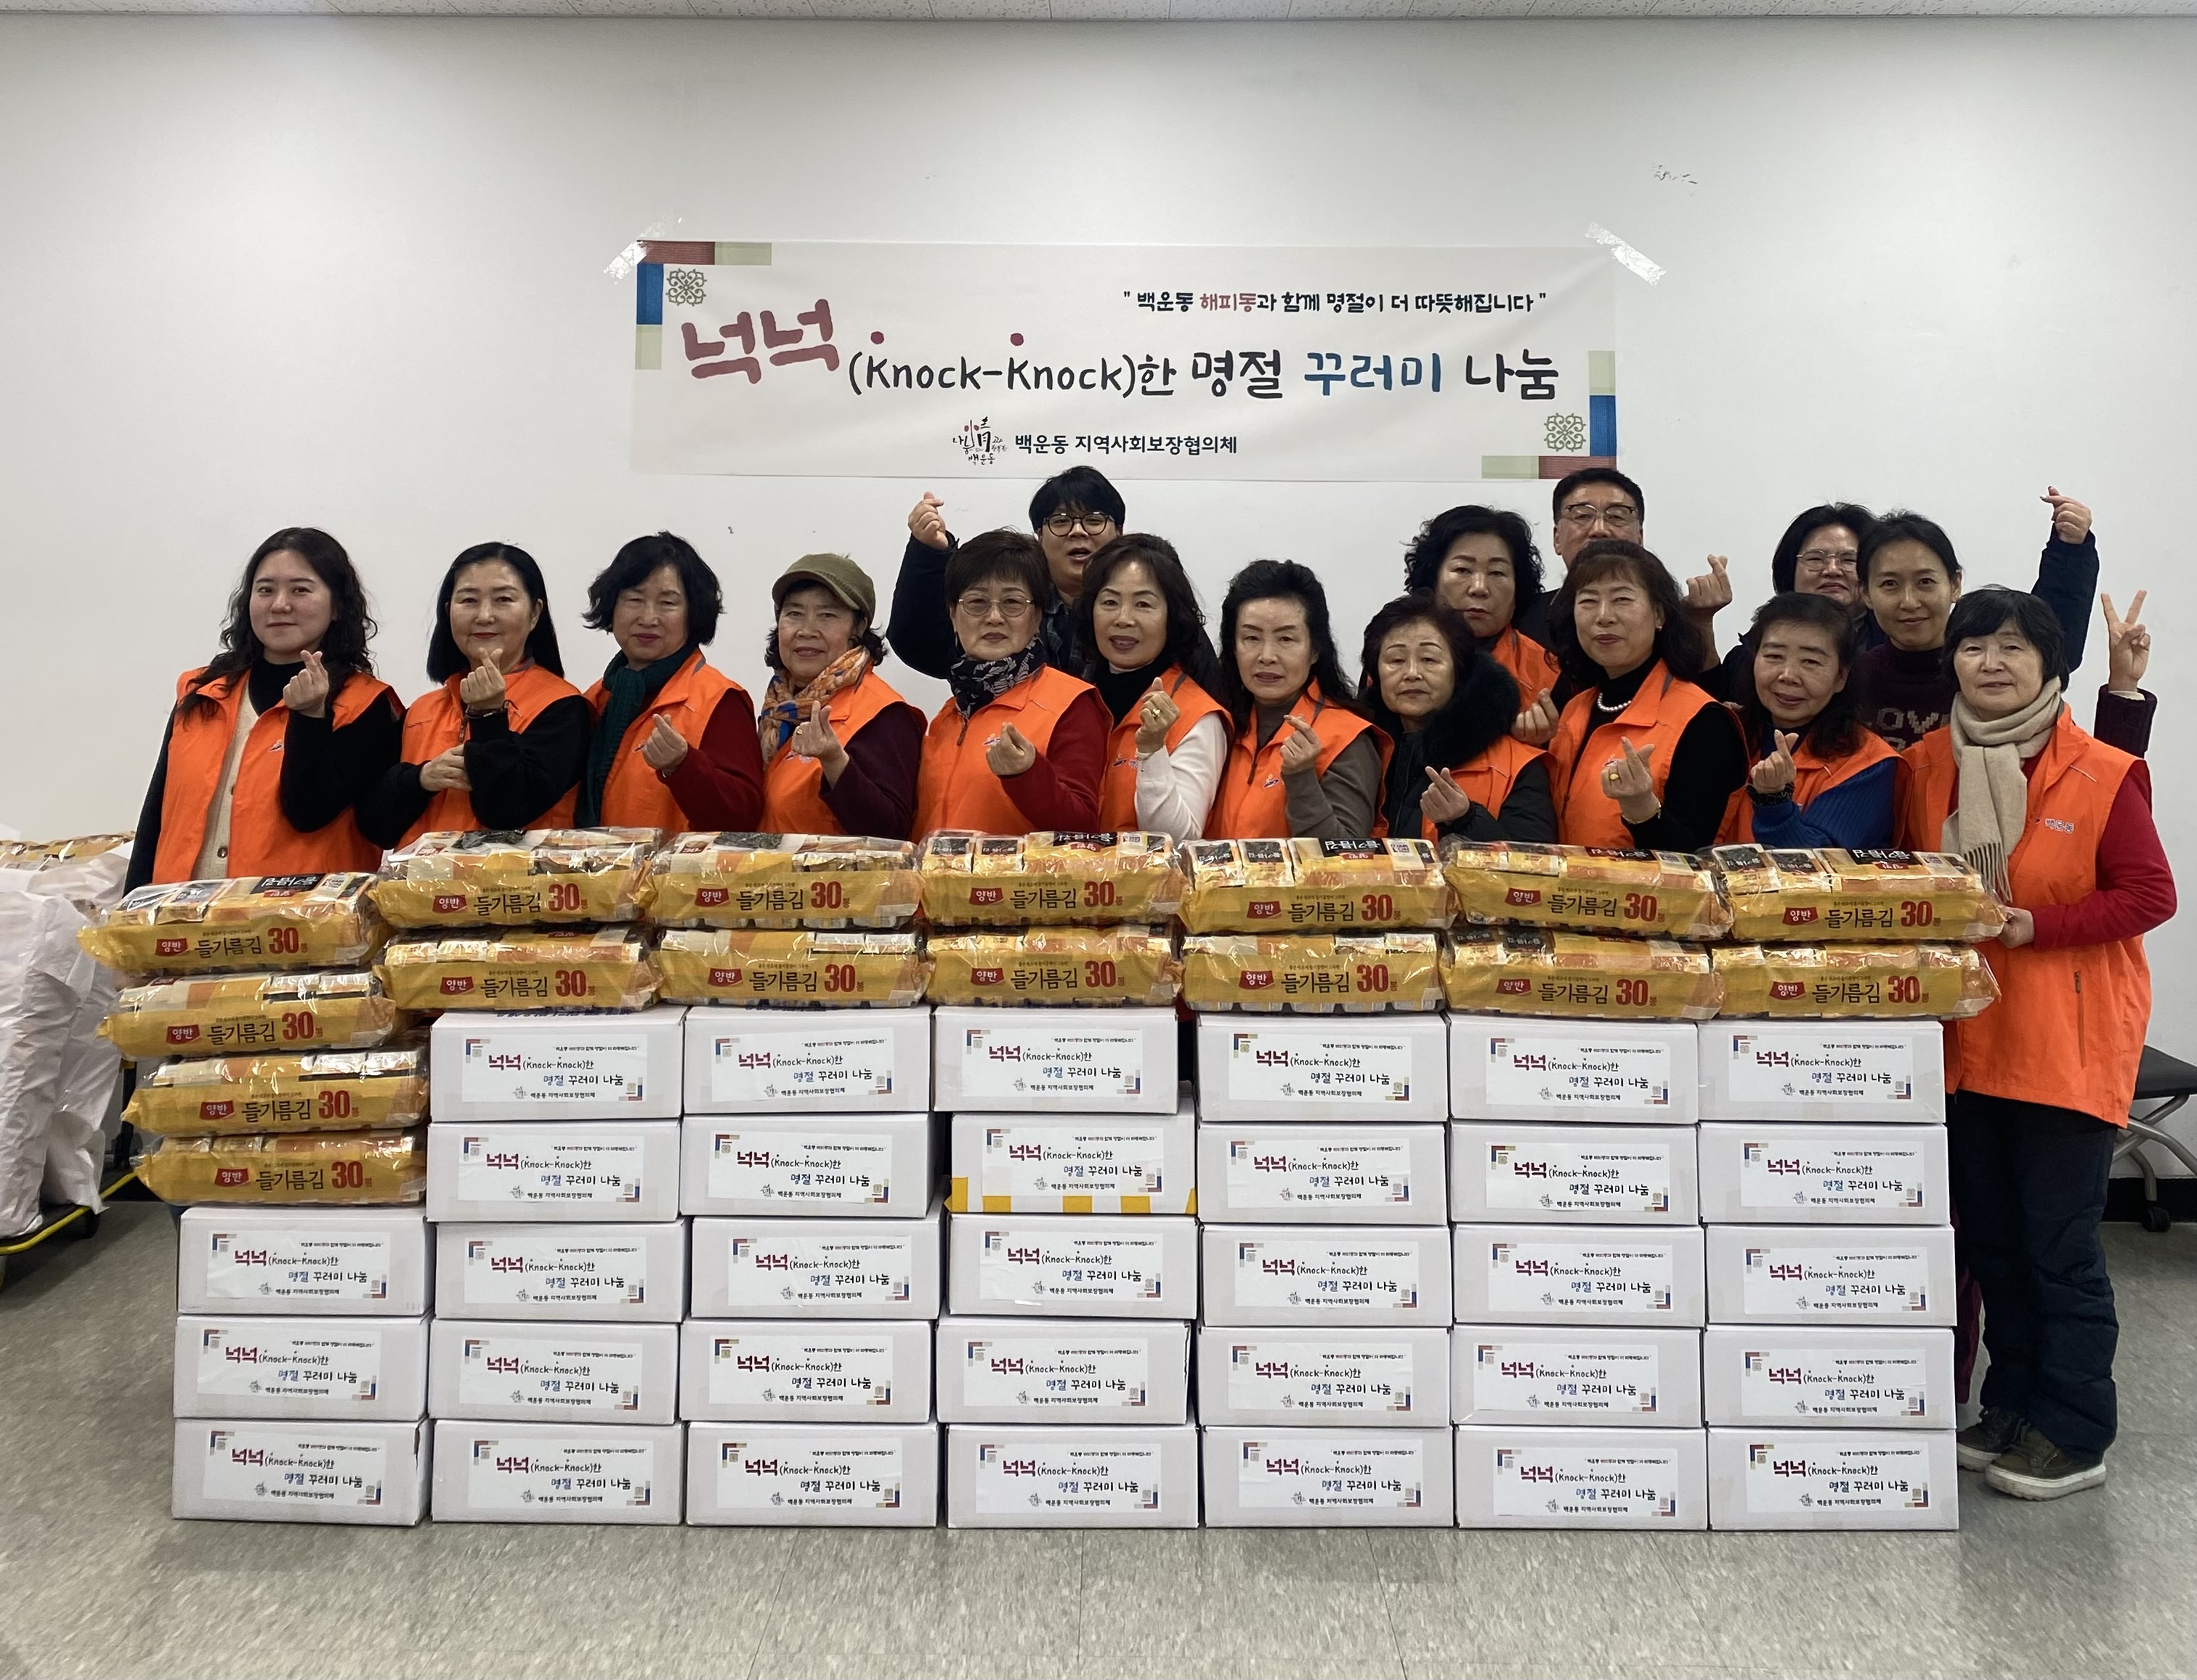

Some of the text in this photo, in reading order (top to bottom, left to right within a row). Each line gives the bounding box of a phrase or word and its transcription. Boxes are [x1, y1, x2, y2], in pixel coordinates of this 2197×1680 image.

[1199, 291, 1276, 313] 해피동과
[1281, 291, 1320, 313] 함께
[1327, 291, 1384, 313] 명절이
[1391, 293, 1409, 312] 더
[1190, 349, 1283, 398] 명절
[1303, 352, 1441, 397] 꾸러미
[1465, 349, 1559, 400] 나눔
[1015, 434, 1069, 455] 백운동
[1075, 435, 1237, 455] 지역사회보장협의체
[439, 897, 460, 910] 양반
[473, 892, 541, 917] 들기름김
[702, 891, 723, 903] 양반
[735, 889, 804, 911] 들기름김
[976, 890, 997, 902] 양반
[1009, 888, 1077, 909] 들기름김
[1512, 890, 1534, 904] 양반
[1546, 893, 1619, 919] 들기름김
[1253, 904, 1274, 915] 양반
[1287, 901, 1355, 922] 들기름김
[1789, 910, 1811, 922] 양반
[1824, 908, 1894, 929] 들기름김
[161, 941, 182, 953] 양반
[195, 936, 262, 959] 들기름김
[446, 979, 467, 991] 양반
[480, 977, 549, 999] 들기름김
[714, 970, 736, 983] 양반
[748, 970, 818, 993] 들기름김
[976, 970, 997, 983] 양반
[1011, 968, 1078, 990] 들기름김
[1246, 973, 1267, 986] 양반
[1281, 972, 1350, 994] 들기름김
[1502, 980, 1525, 993] 양반
[1537, 981, 1609, 1006] 들기름김
[1776, 984, 1798, 996] 양반
[1811, 983, 1881, 1005] 들기름김
[172, 1027, 193, 1041] 양반
[207, 1021, 275, 1047] 들기름김
[793, 1068, 873, 1083] 명절 꾸러미 나눔
[1311, 1073, 1390, 1085] 명절 꾸러미 나눔
[1812, 1073, 1891, 1084] 명절 꾸러미 나눔
[206, 1103, 227, 1116] 양반
[241, 1099, 312, 1123] 들기름김
[221, 1171, 242, 1183] 양반
[256, 1169, 325, 1191] 들기름김
[541, 1175, 621, 1186] 명절 꾸러미 나눔
[1064, 1165, 1142, 1177] 명절 꾸러미 나눔
[1569, 1184, 1648, 1196] 명절 꾸러미 나눔
[288, 1271, 368, 1283] 명절 꾸러미 나눔
[810, 1273, 889, 1286] 명절 꾸러미 나눔
[1318, 1281, 1397, 1292] 명절 꾸러미 나눔
[1826, 1283, 1906, 1296] 명절 꾸러미 나눔
[541, 1380, 619, 1394] 명절 꾸러미 나눔
[1046, 1379, 1126, 1391] 명절 꾸러미 나눔
[1557, 1384, 1636, 1396] 명절 꾸러미 나눔
[284, 1473, 363, 1488] 명절 꾸러미 나눔
[801, 1480, 881, 1492] 명절 꾸러미 나눔
[1322, 1480, 1401, 1491] 명절 꾸러미 나눔
